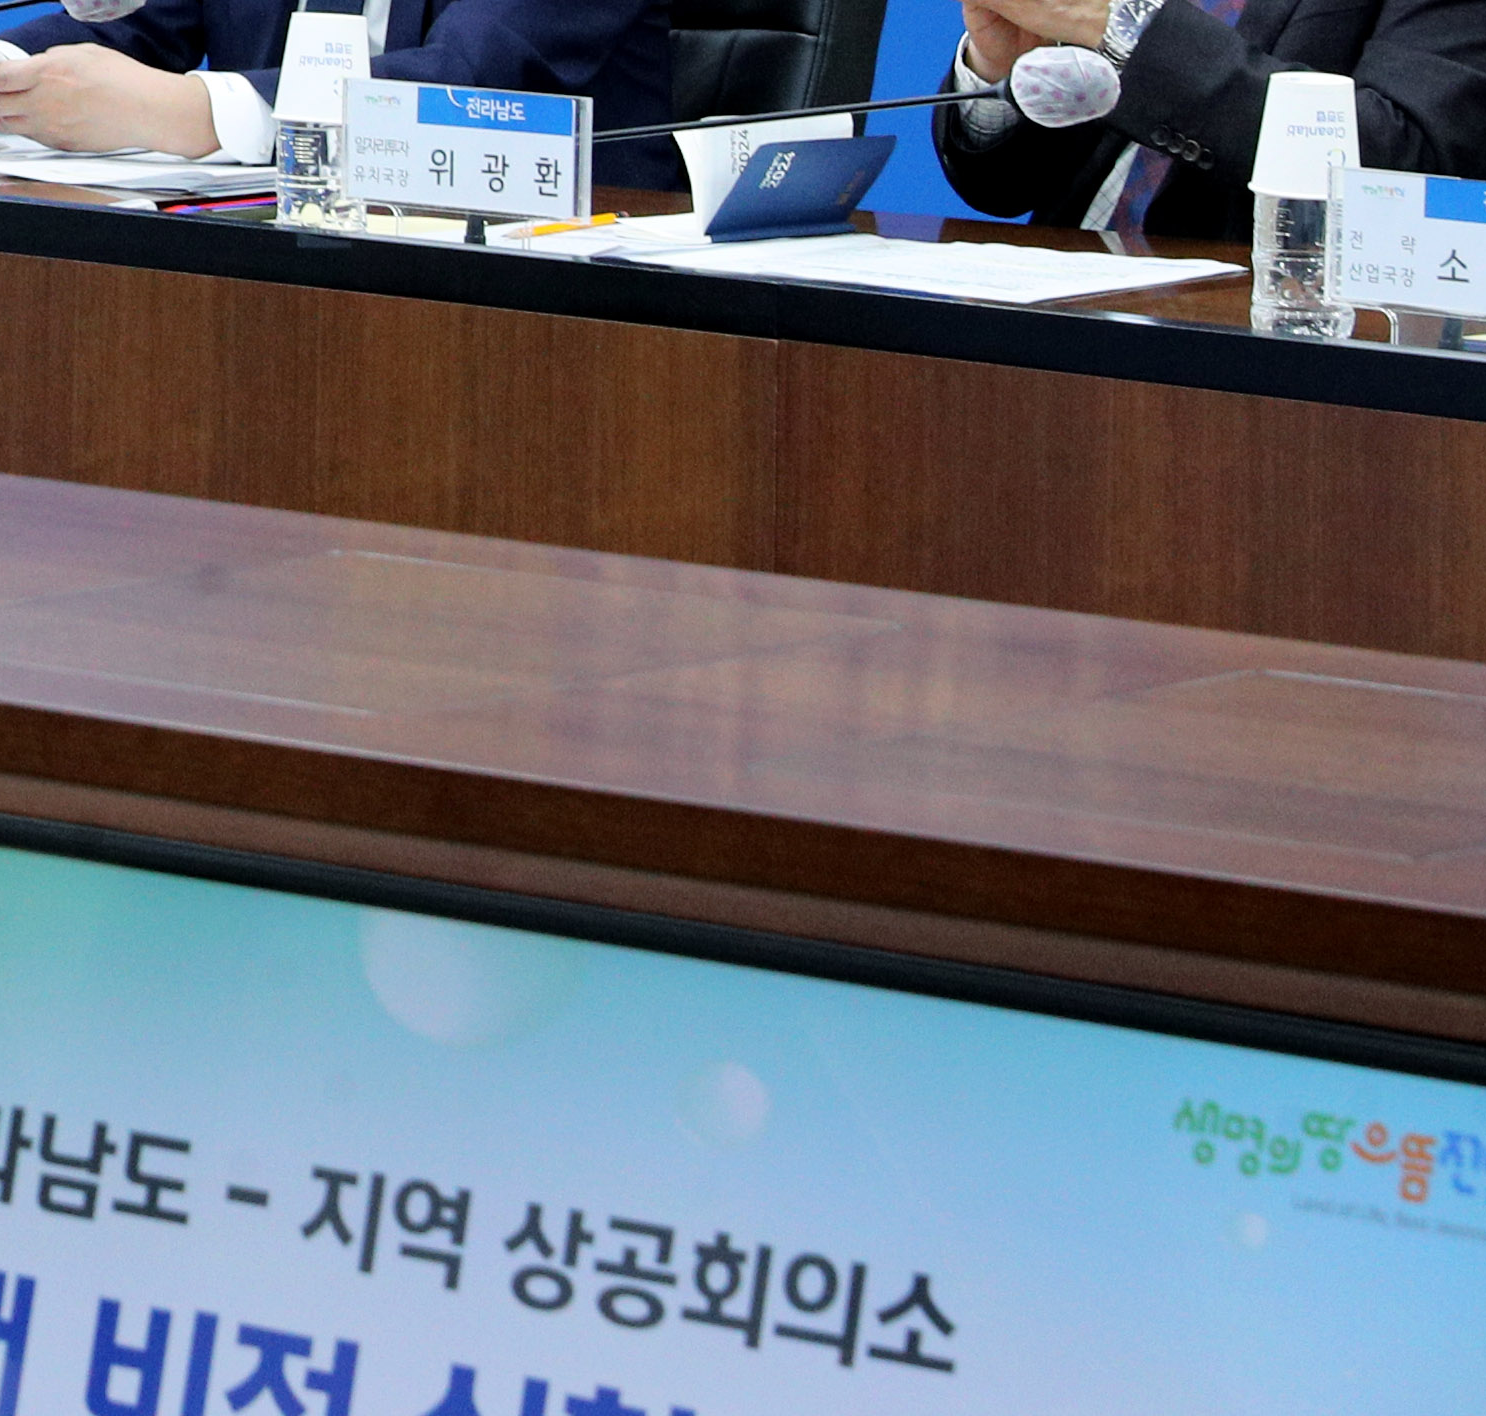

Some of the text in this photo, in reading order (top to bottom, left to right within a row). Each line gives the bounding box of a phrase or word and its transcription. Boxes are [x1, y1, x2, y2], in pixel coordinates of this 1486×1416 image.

[465, 97, 526, 122] 전라남도
[1286, 124, 1347, 140] Cleanlab
[354, 136, 410, 156] 일자리투자
[353, 166, 409, 188] 유치국장
[1349, 262, 1415, 288] 산업국장
[303, 1167, 472, 1290] 지역
[507, 1205, 956, 1374] 상공회의소
